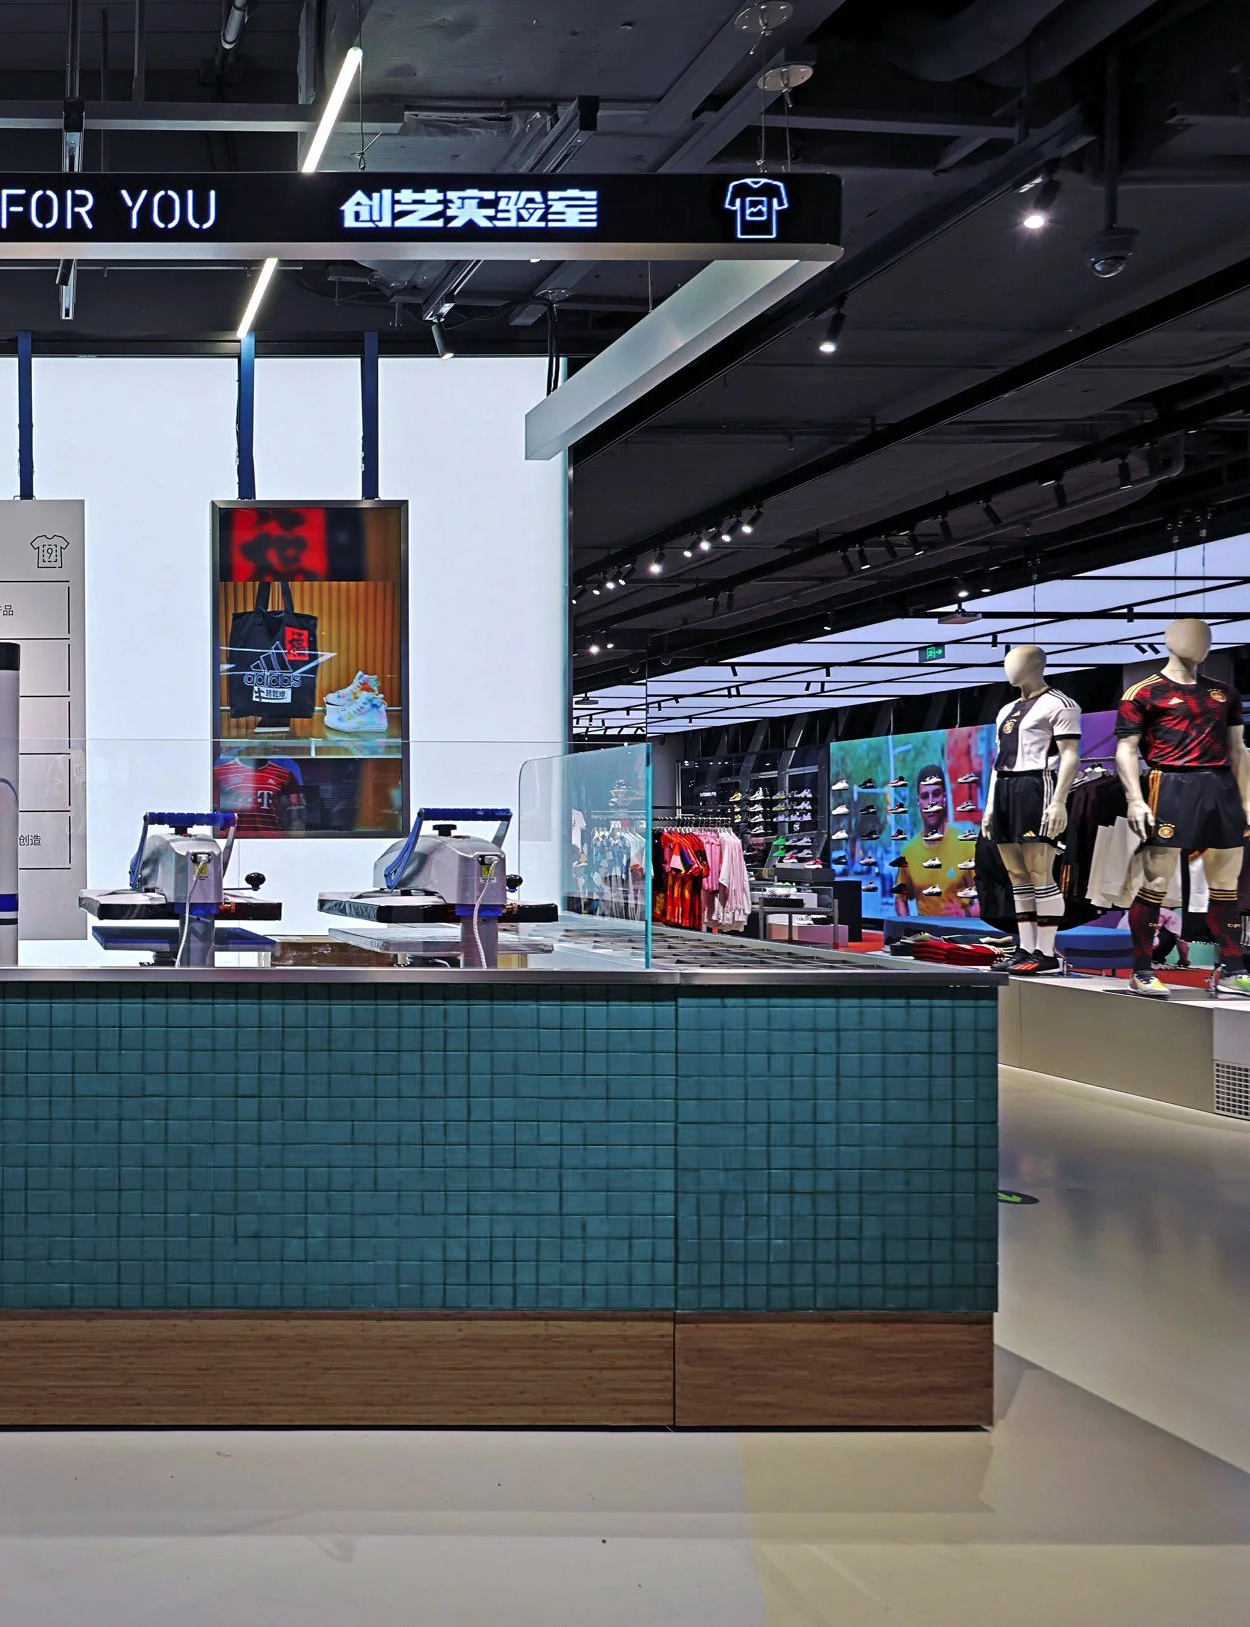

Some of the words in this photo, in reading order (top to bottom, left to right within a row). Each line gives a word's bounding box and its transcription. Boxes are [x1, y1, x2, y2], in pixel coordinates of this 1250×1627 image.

[1, 188, 94, 230] FOR
[120, 189, 216, 230] YOU
[340, 188, 598, 228] 创艺实验室
[243, 671, 302, 688] adidas
[18, 834, 41, 846] 创造
